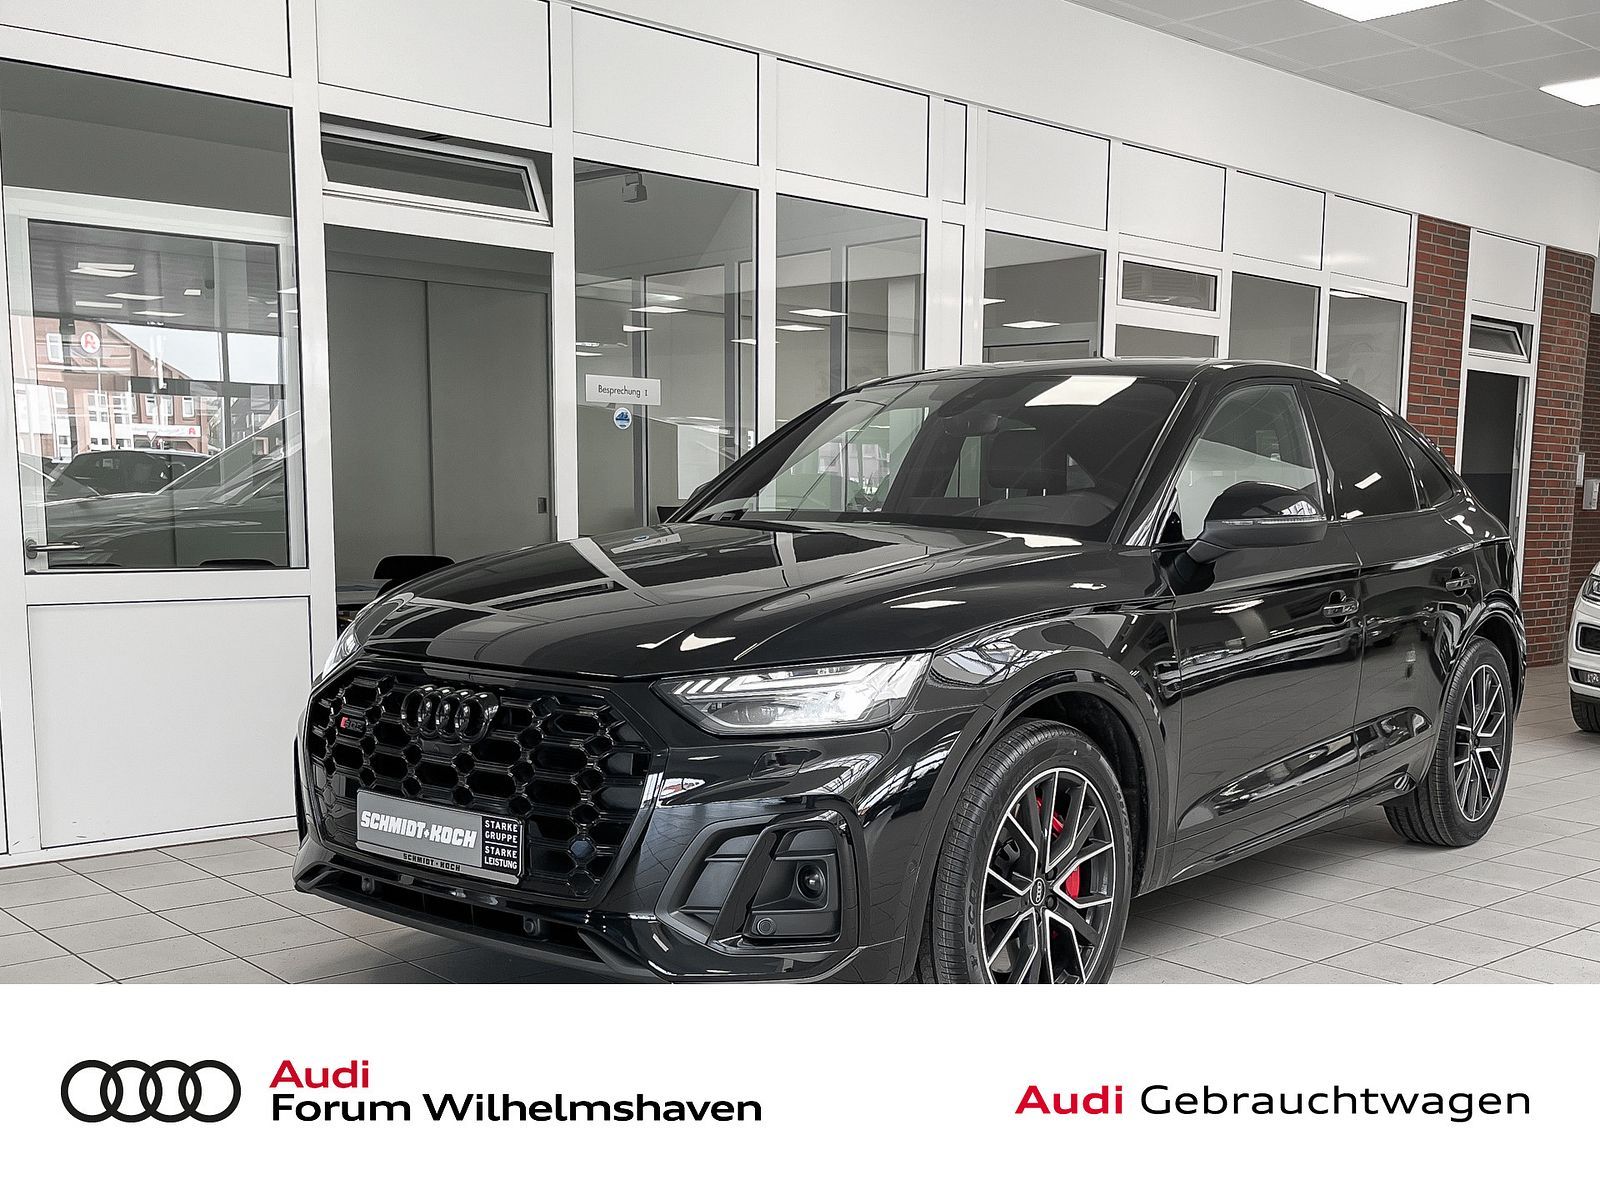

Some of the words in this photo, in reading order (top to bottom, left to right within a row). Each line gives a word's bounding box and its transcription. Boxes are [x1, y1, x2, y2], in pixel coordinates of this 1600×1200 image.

[598, 384, 641, 398] Besprechung
[484, 819, 518, 832] STARKE
[484, 830, 518, 844] GRUPPE
[484, 845, 518, 858] STARKE
[484, 856, 518, 870] LEISTUNG
